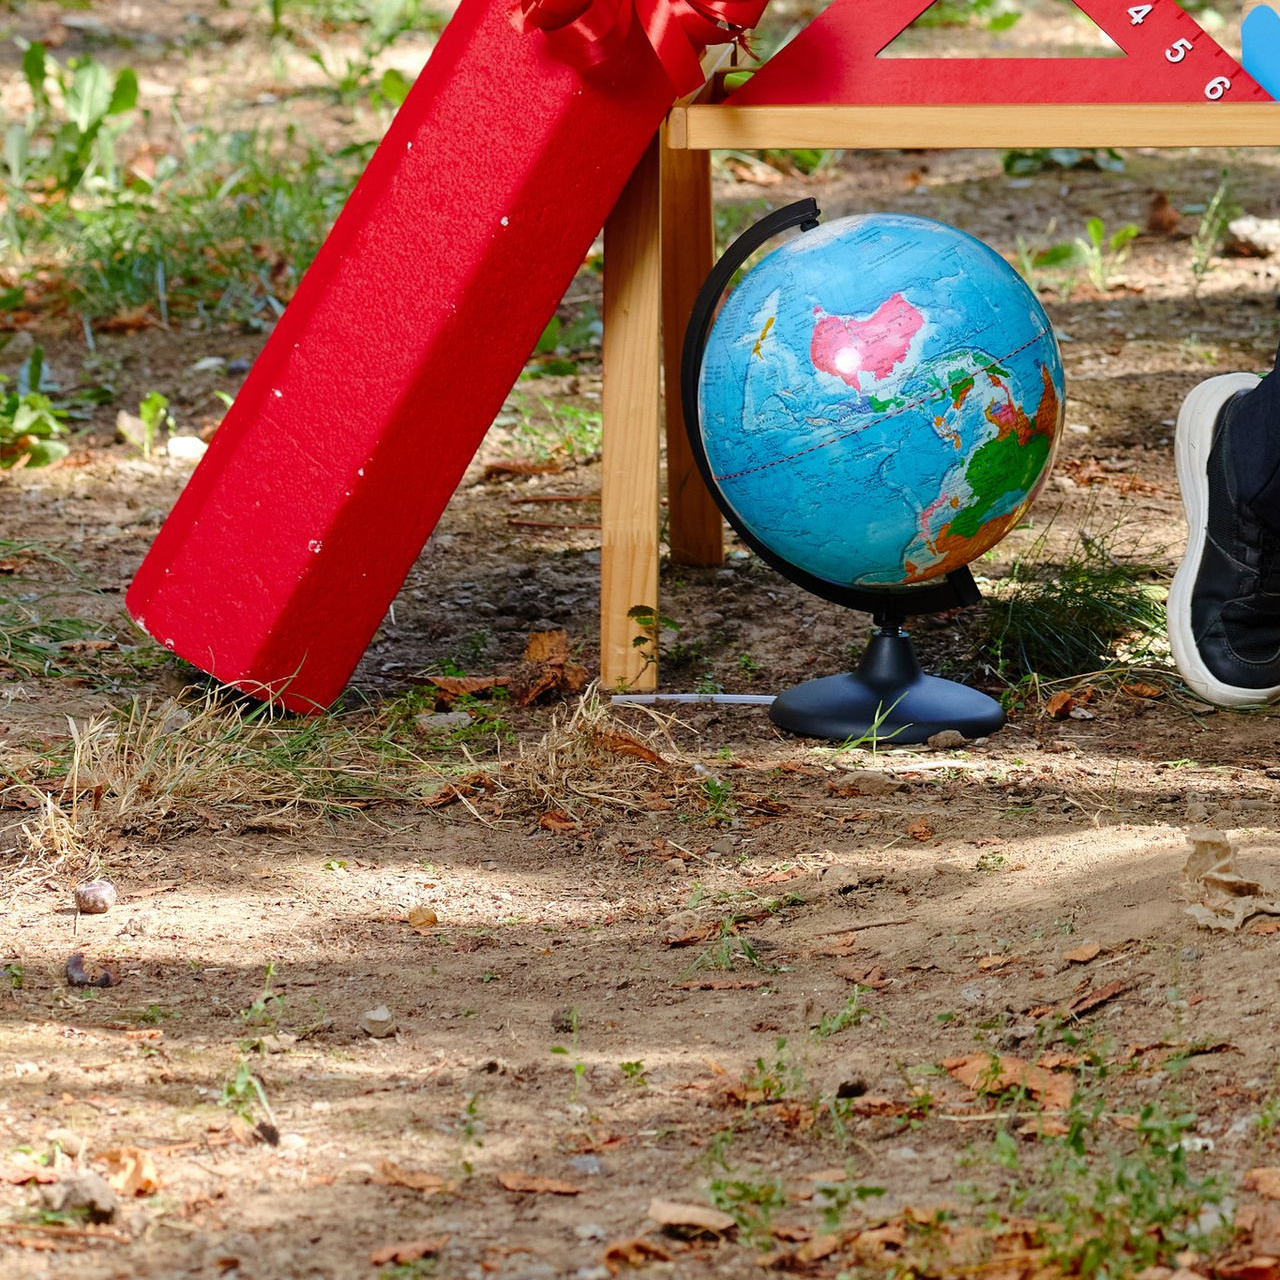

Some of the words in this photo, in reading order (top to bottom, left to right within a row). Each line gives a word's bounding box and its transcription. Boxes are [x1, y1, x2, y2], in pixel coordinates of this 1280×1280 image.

[1126, 3, 1154, 27] 4
[1164, 37, 1194, 64] 5
[1203, 75, 1232, 101] 6
